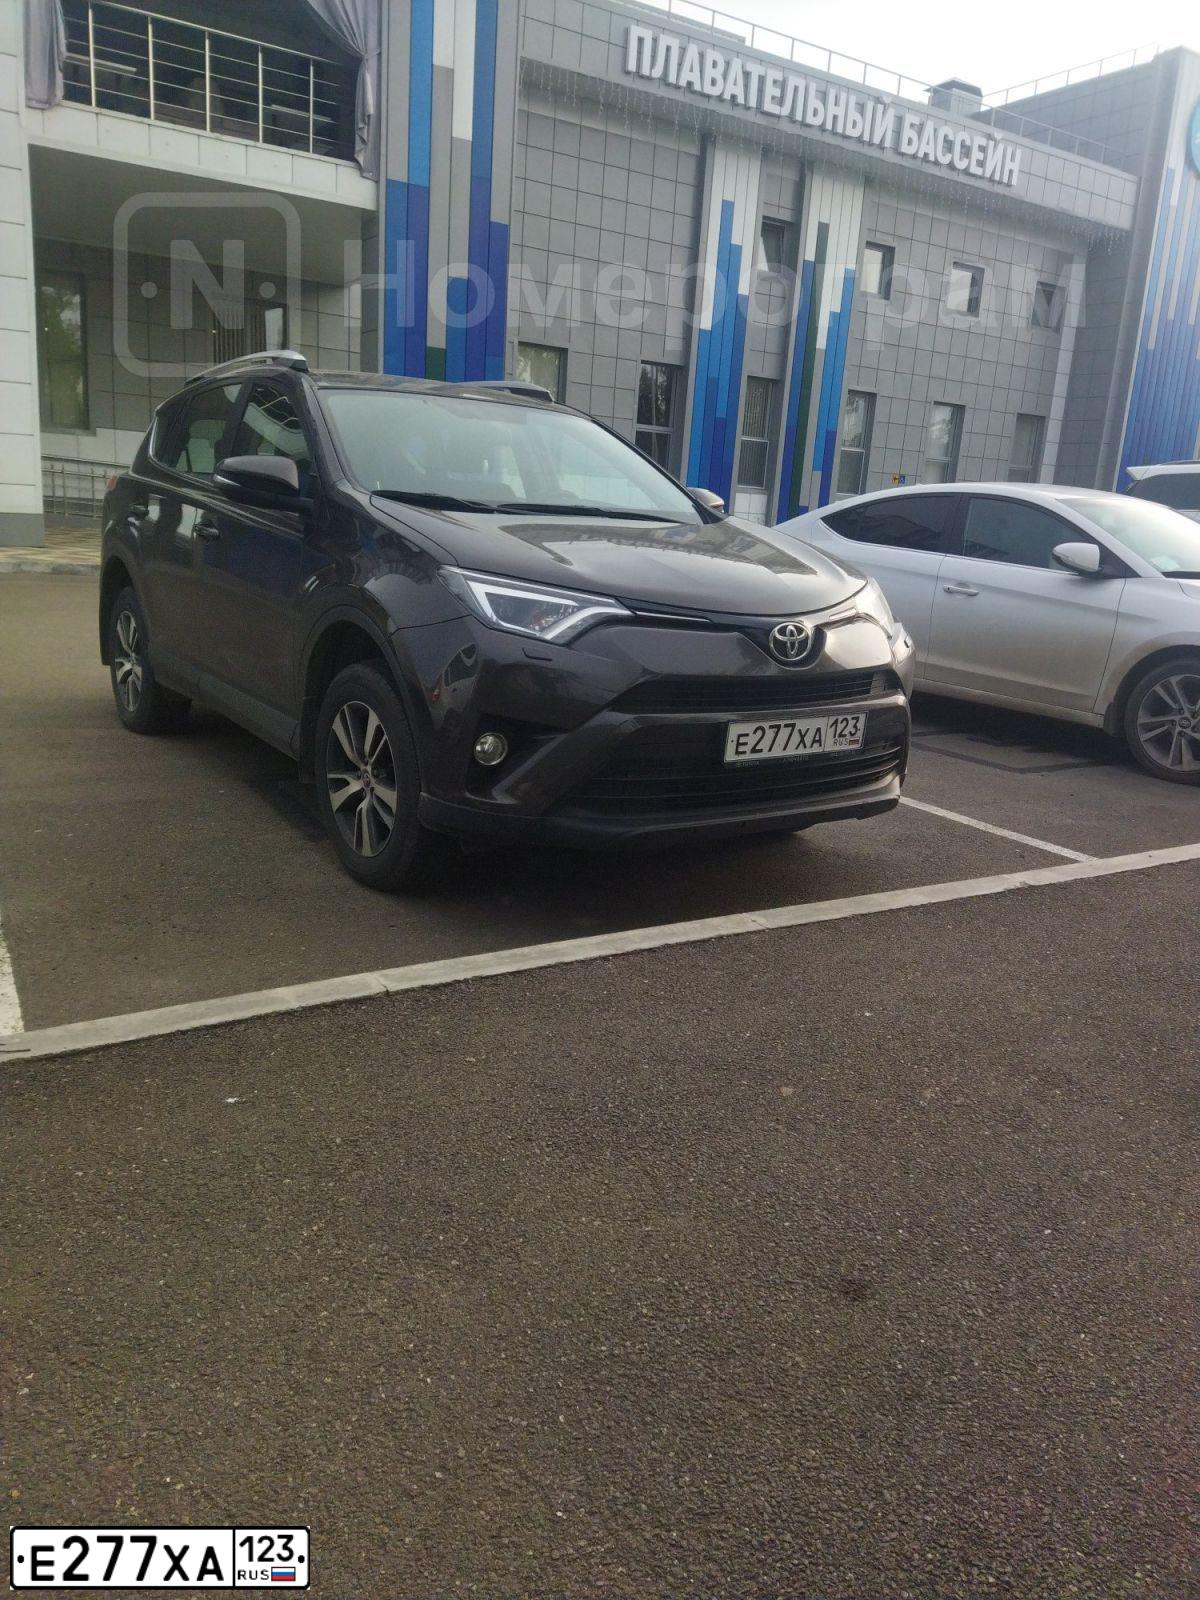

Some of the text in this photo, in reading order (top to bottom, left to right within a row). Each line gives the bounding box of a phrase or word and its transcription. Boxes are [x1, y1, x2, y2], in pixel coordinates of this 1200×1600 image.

[627, 24, 1023, 186] ПЛАВАТЕЛЬНЫЙ БАССЕЙН
[735, 716, 860, 755] Е277ХА 123
[833, 737, 849, 747] RUS
